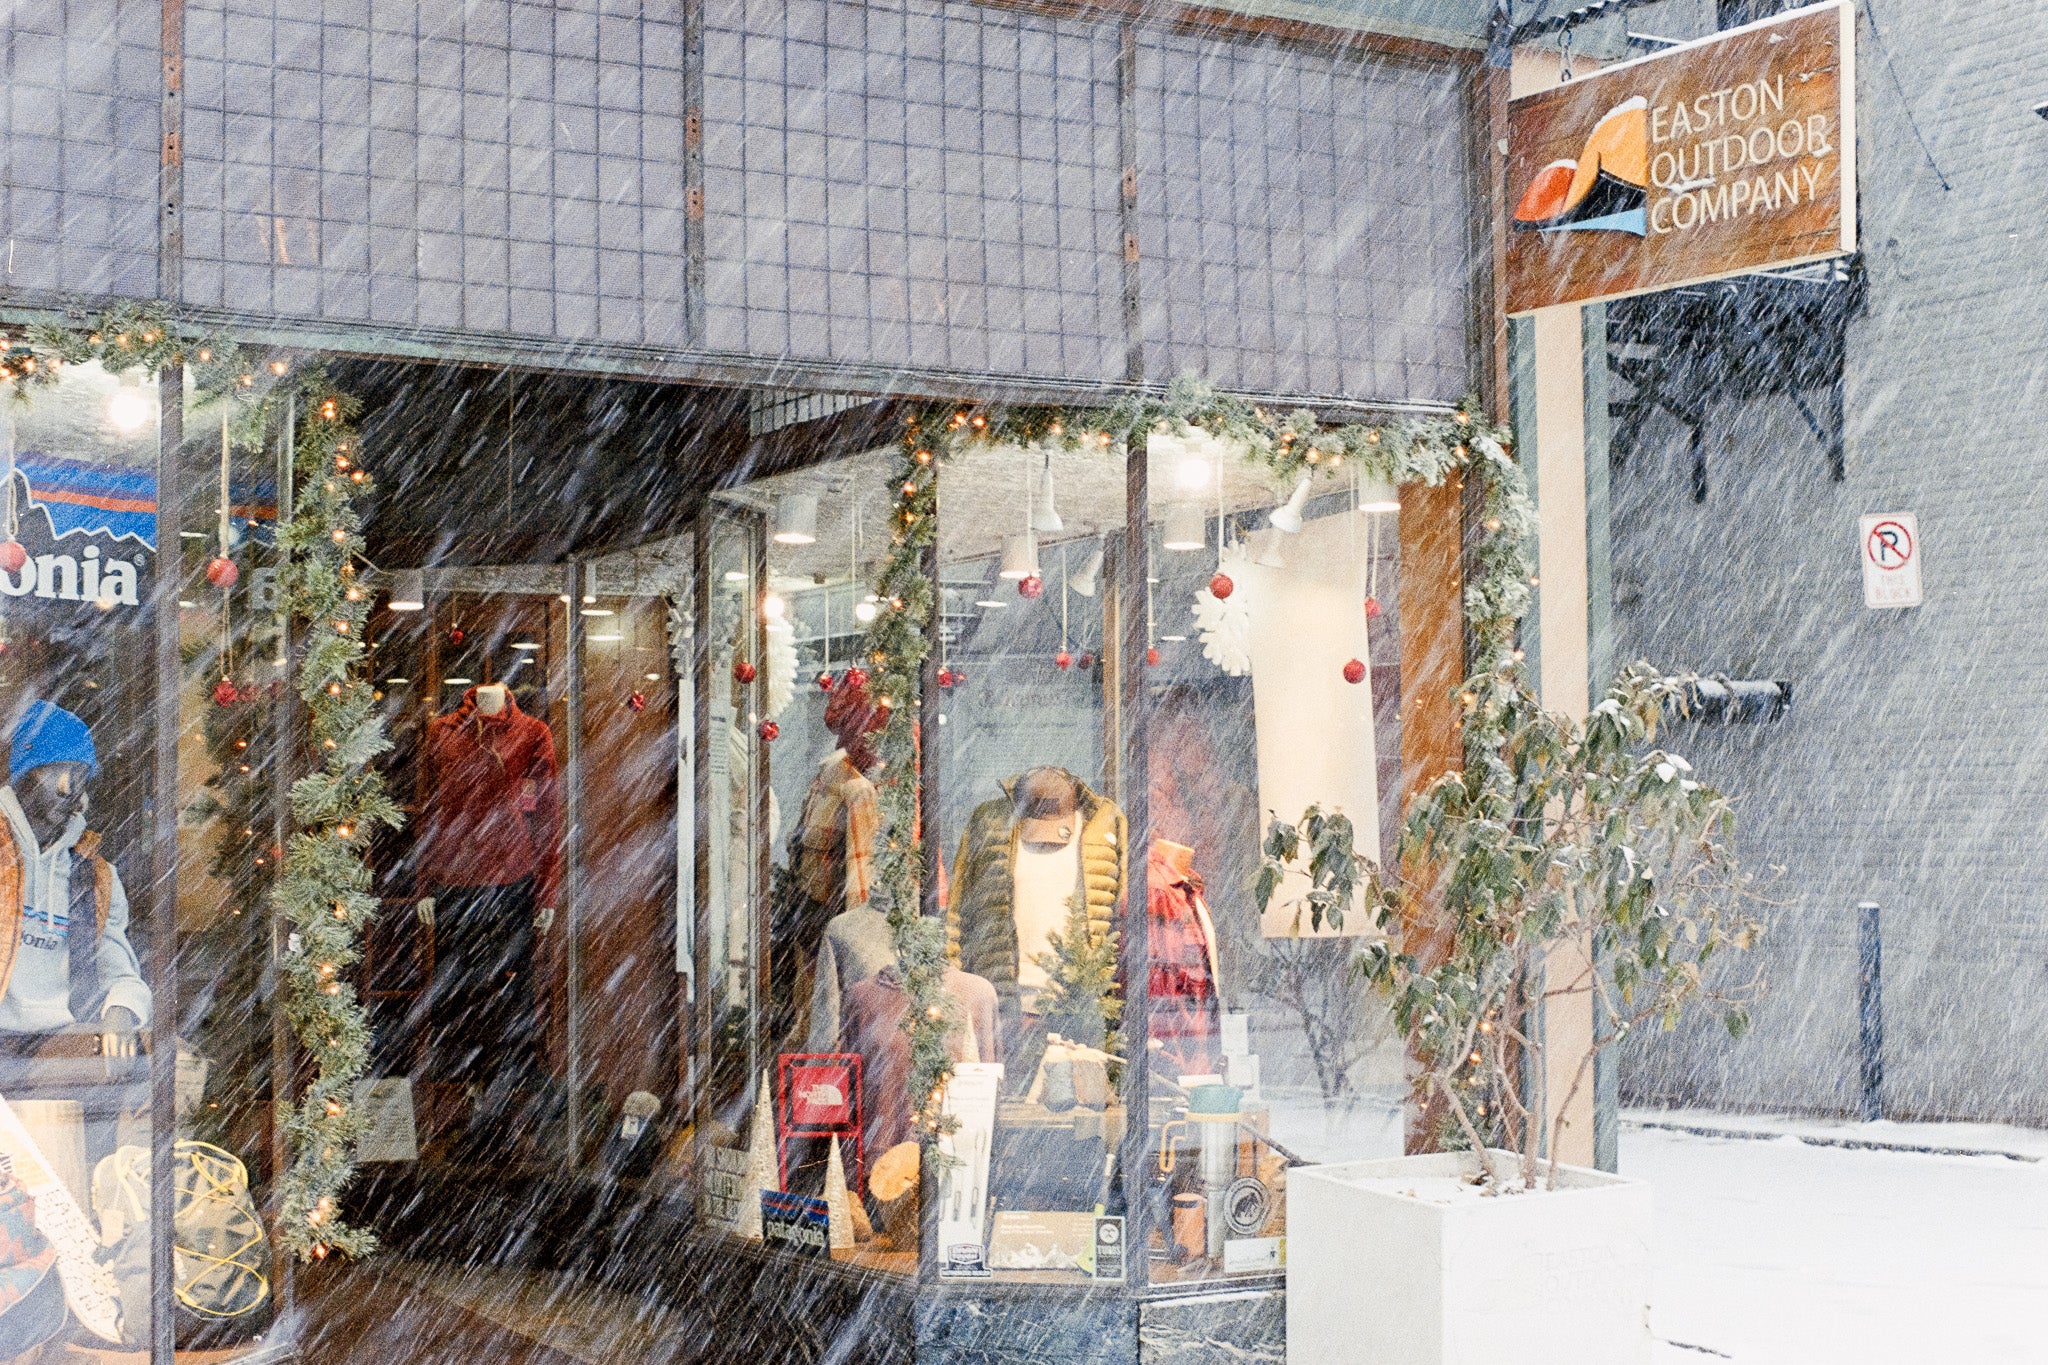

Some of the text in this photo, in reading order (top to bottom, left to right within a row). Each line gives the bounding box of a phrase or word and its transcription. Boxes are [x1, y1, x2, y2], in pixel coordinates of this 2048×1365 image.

[1652, 73, 1785, 143] EASTON
[1651, 113, 1829, 189] OUTDOOR
[1651, 163, 1823, 234] COMPANY
